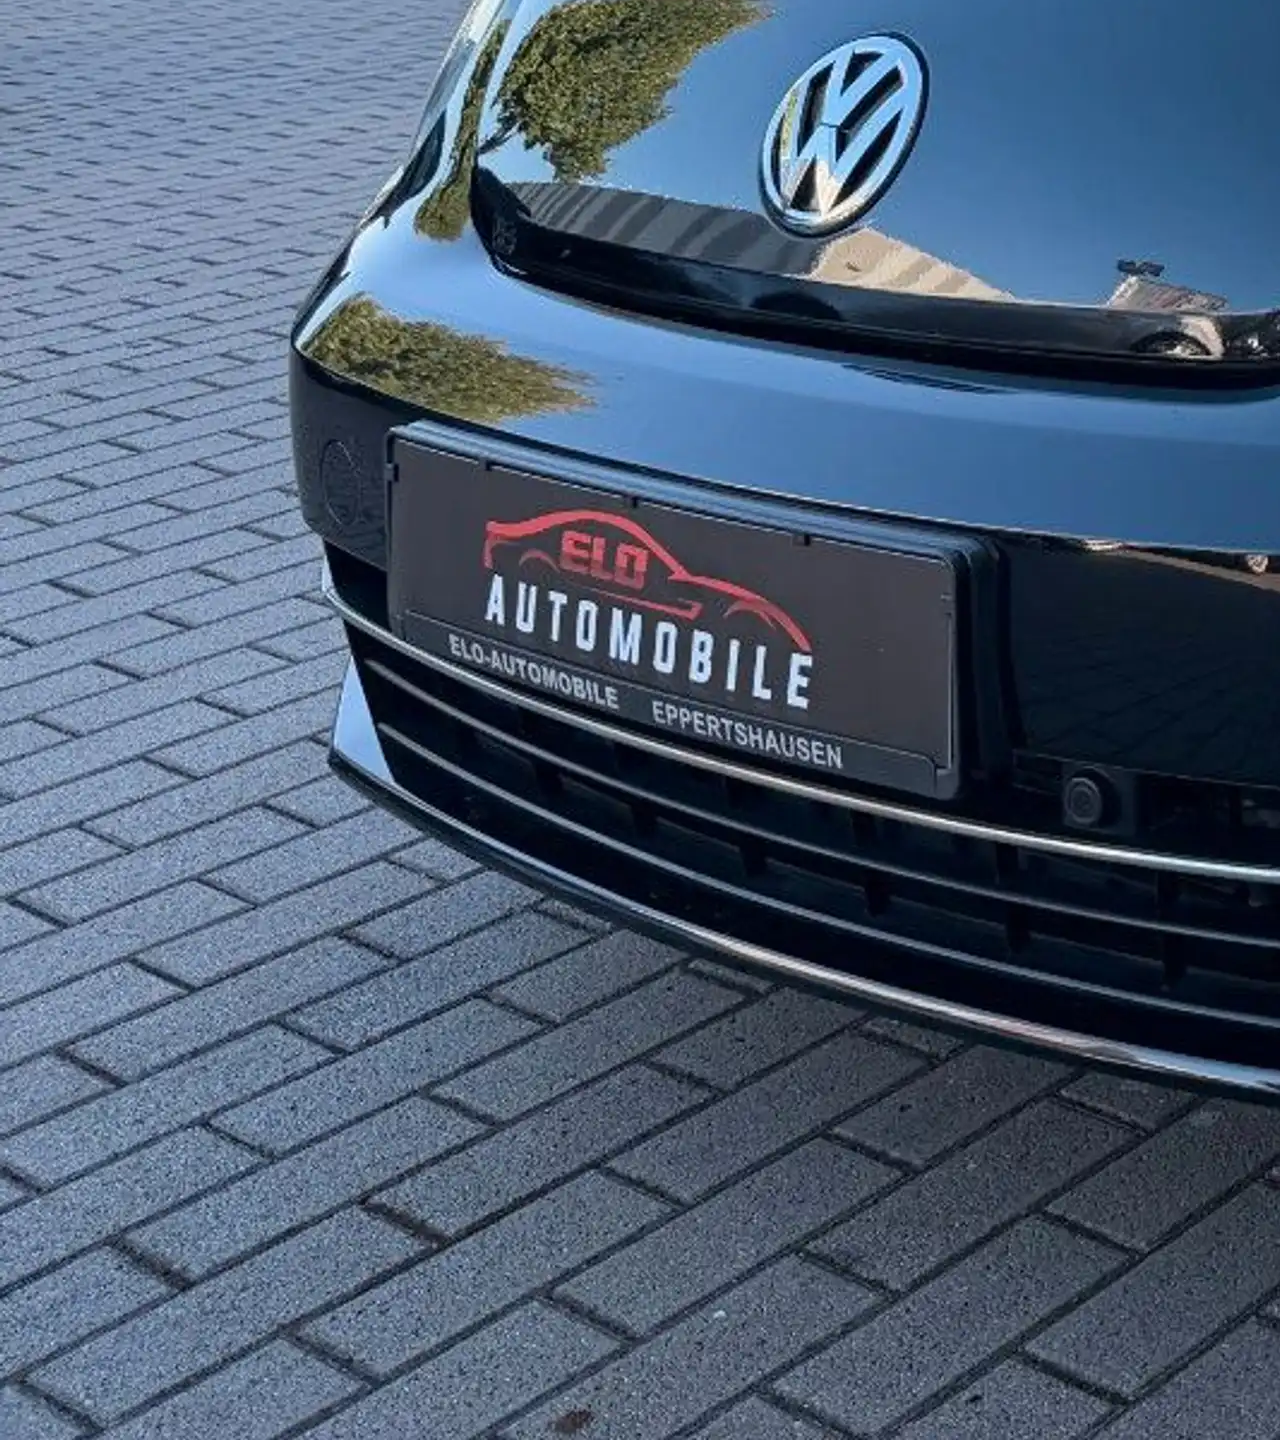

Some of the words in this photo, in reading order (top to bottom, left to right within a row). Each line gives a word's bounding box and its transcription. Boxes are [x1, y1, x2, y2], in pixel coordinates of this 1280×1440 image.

[559, 529, 651, 590] ELO
[448, 632, 621, 712] ELO-AUTOMOBILE
[651, 699, 845, 770] EPPERTSHAUSEN
[484, 573, 814, 710] AUTOMOBILE
